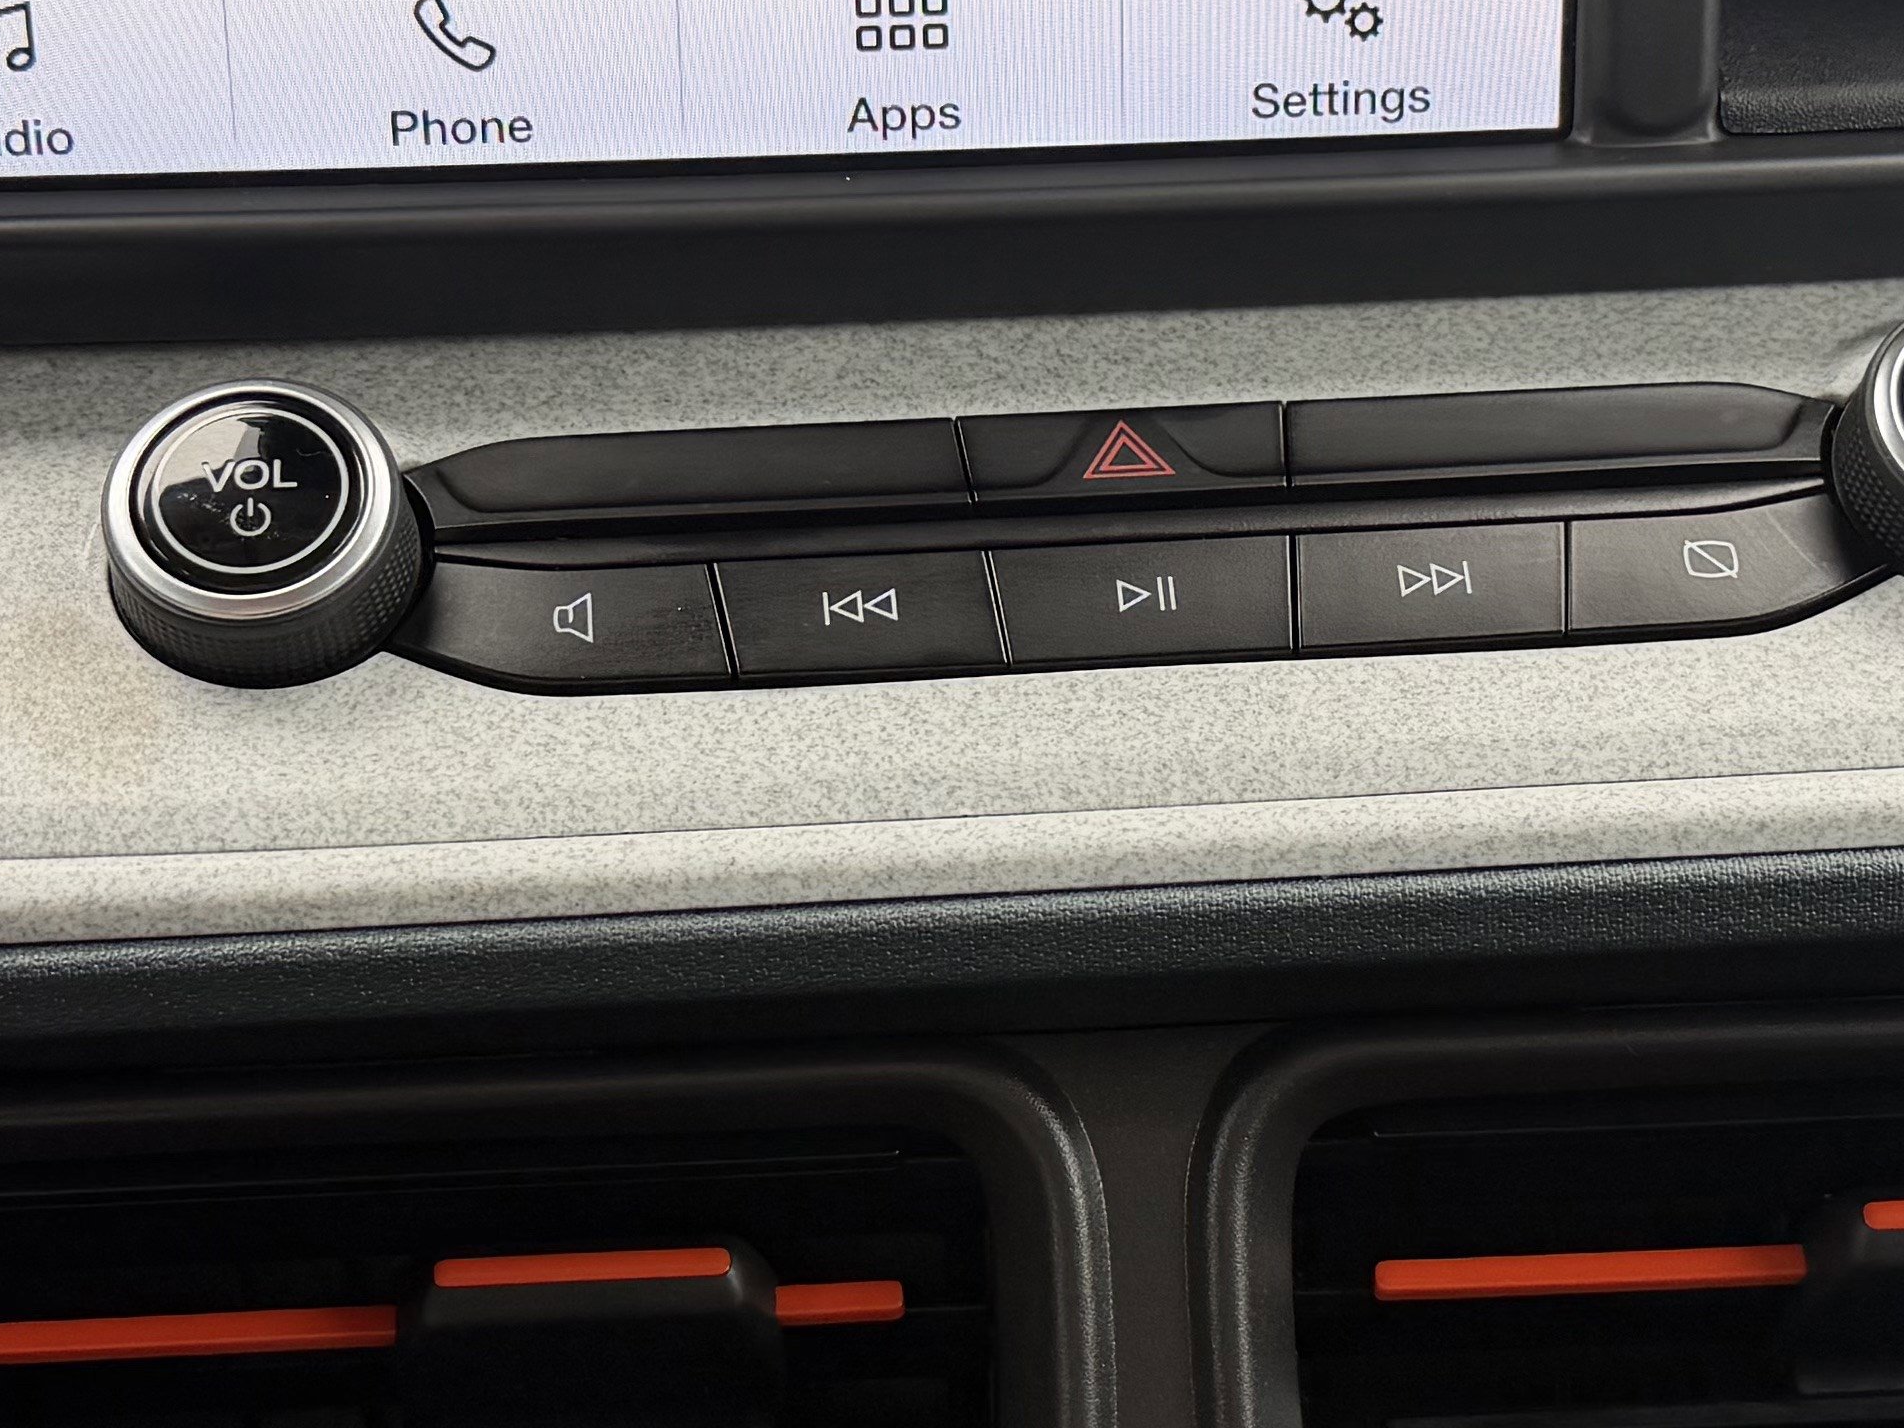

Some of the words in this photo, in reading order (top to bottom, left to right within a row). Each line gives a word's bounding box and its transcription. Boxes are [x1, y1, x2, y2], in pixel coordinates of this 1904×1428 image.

[847, 96, 962, 141] Apps
[1251, 79, 1432, 123] Settings
[390, 107, 533, 147] Phone
[201, 458, 298, 492] VOL
